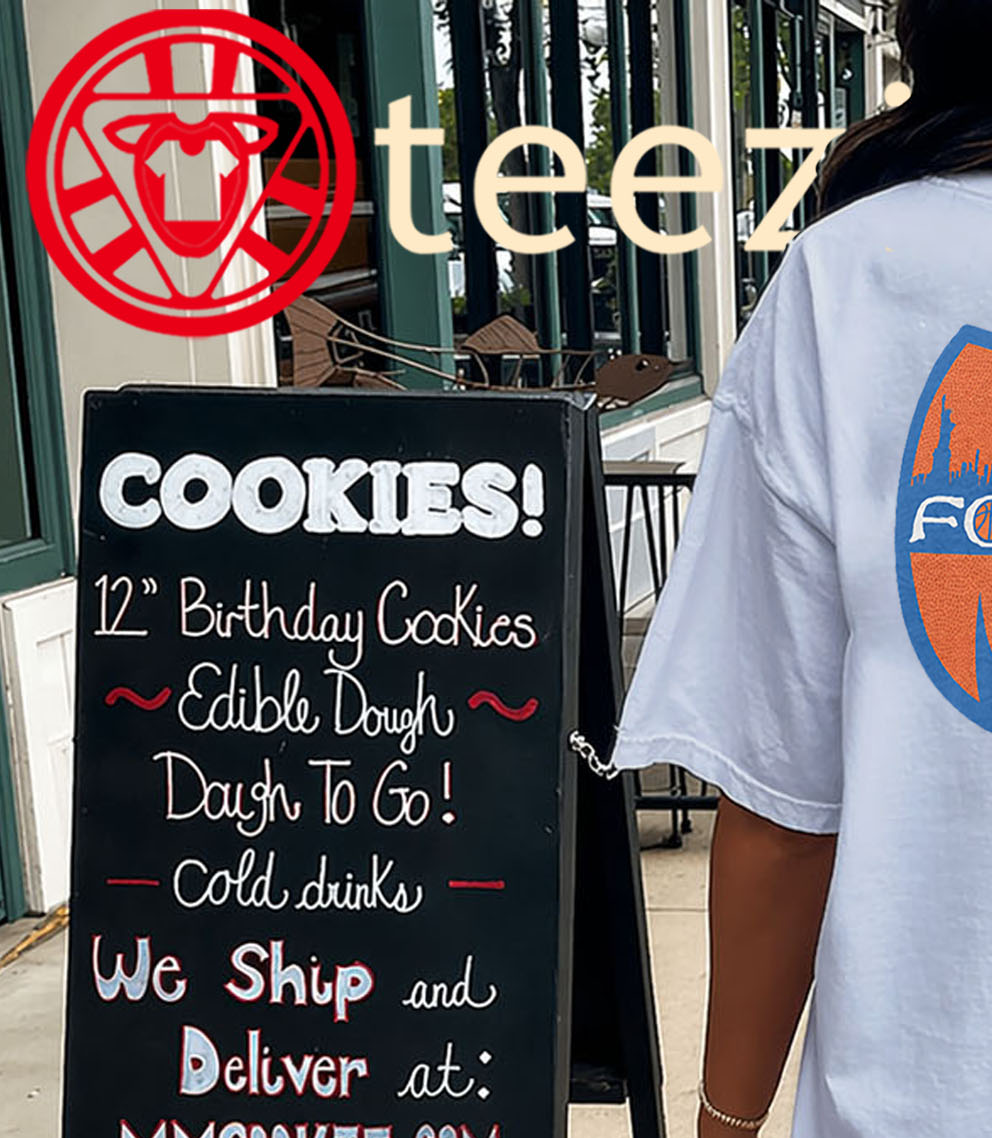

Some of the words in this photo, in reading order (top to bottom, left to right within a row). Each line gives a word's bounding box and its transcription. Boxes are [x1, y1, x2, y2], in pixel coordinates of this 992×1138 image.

[99, 452, 544, 538] COOKIES!
[180, 576, 364, 670] Birthday
[177, 662, 320, 733] Edible
[322, 669, 455, 755] Dough
[152, 750, 302, 836] Dough
[307, 759, 356, 825] To
[173, 847, 290, 910] Cold
[92, 934, 188, 1003] We
[223, 939, 374, 1022] Ship
[401, 954, 497, 1009] and
[179, 1025, 369, 1098] Deliver
[397, 1042, 492, 1100] at:
